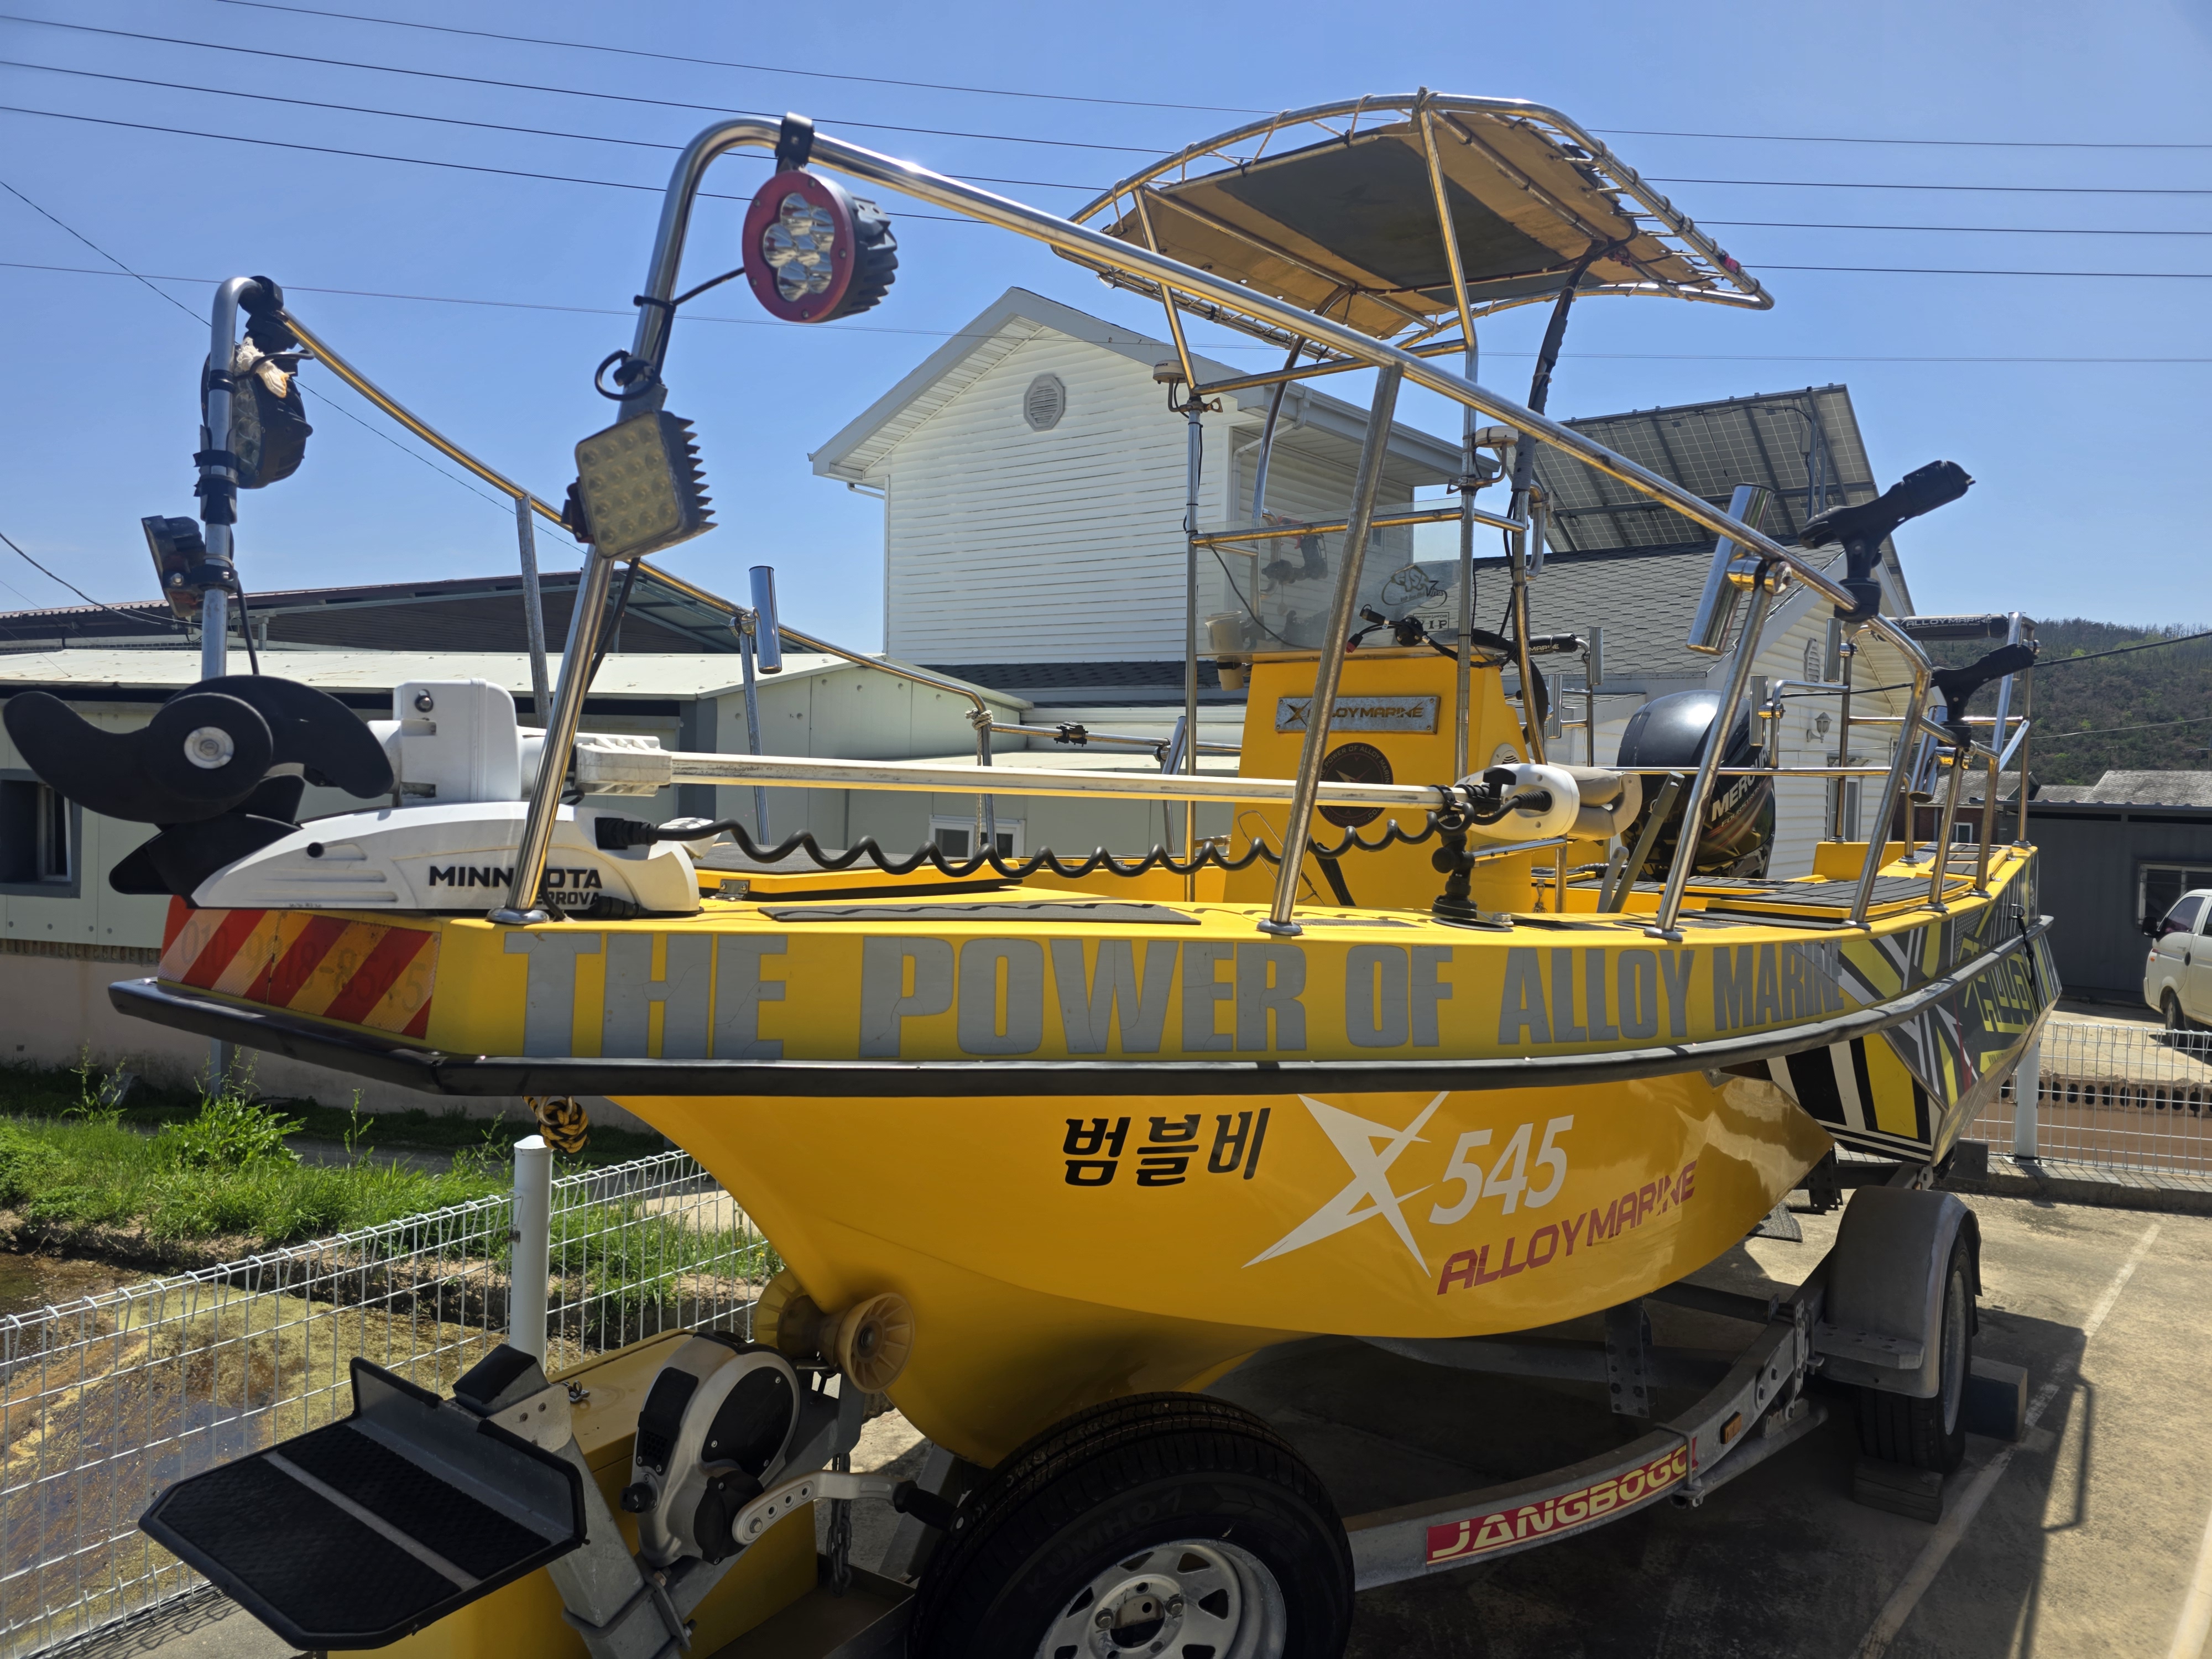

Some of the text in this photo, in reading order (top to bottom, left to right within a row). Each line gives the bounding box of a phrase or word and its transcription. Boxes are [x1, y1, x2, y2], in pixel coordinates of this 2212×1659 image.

[1324, 748, 1347, 767] POWER
[1360, 746, 1381, 760] ALLOY
[1379, 759, 1390, 783] MARIN
[546, 868, 602, 889] OTA
[504, 932, 788, 1059] THE
[858, 936, 1307, 1058] POWER
[1346, 945, 1453, 1048] OF
[1498, 947, 1695, 1046] ALLOY
[1712, 938, 1844, 1031] MARINE
[1062, 1107, 1271, 1187] 범블비
[1428, 1114, 1574, 1225] 545
[1437, 1160, 1698, 1296] ALLOYMARINE
[1024, 1500, 1157, 1596] KUMHO
